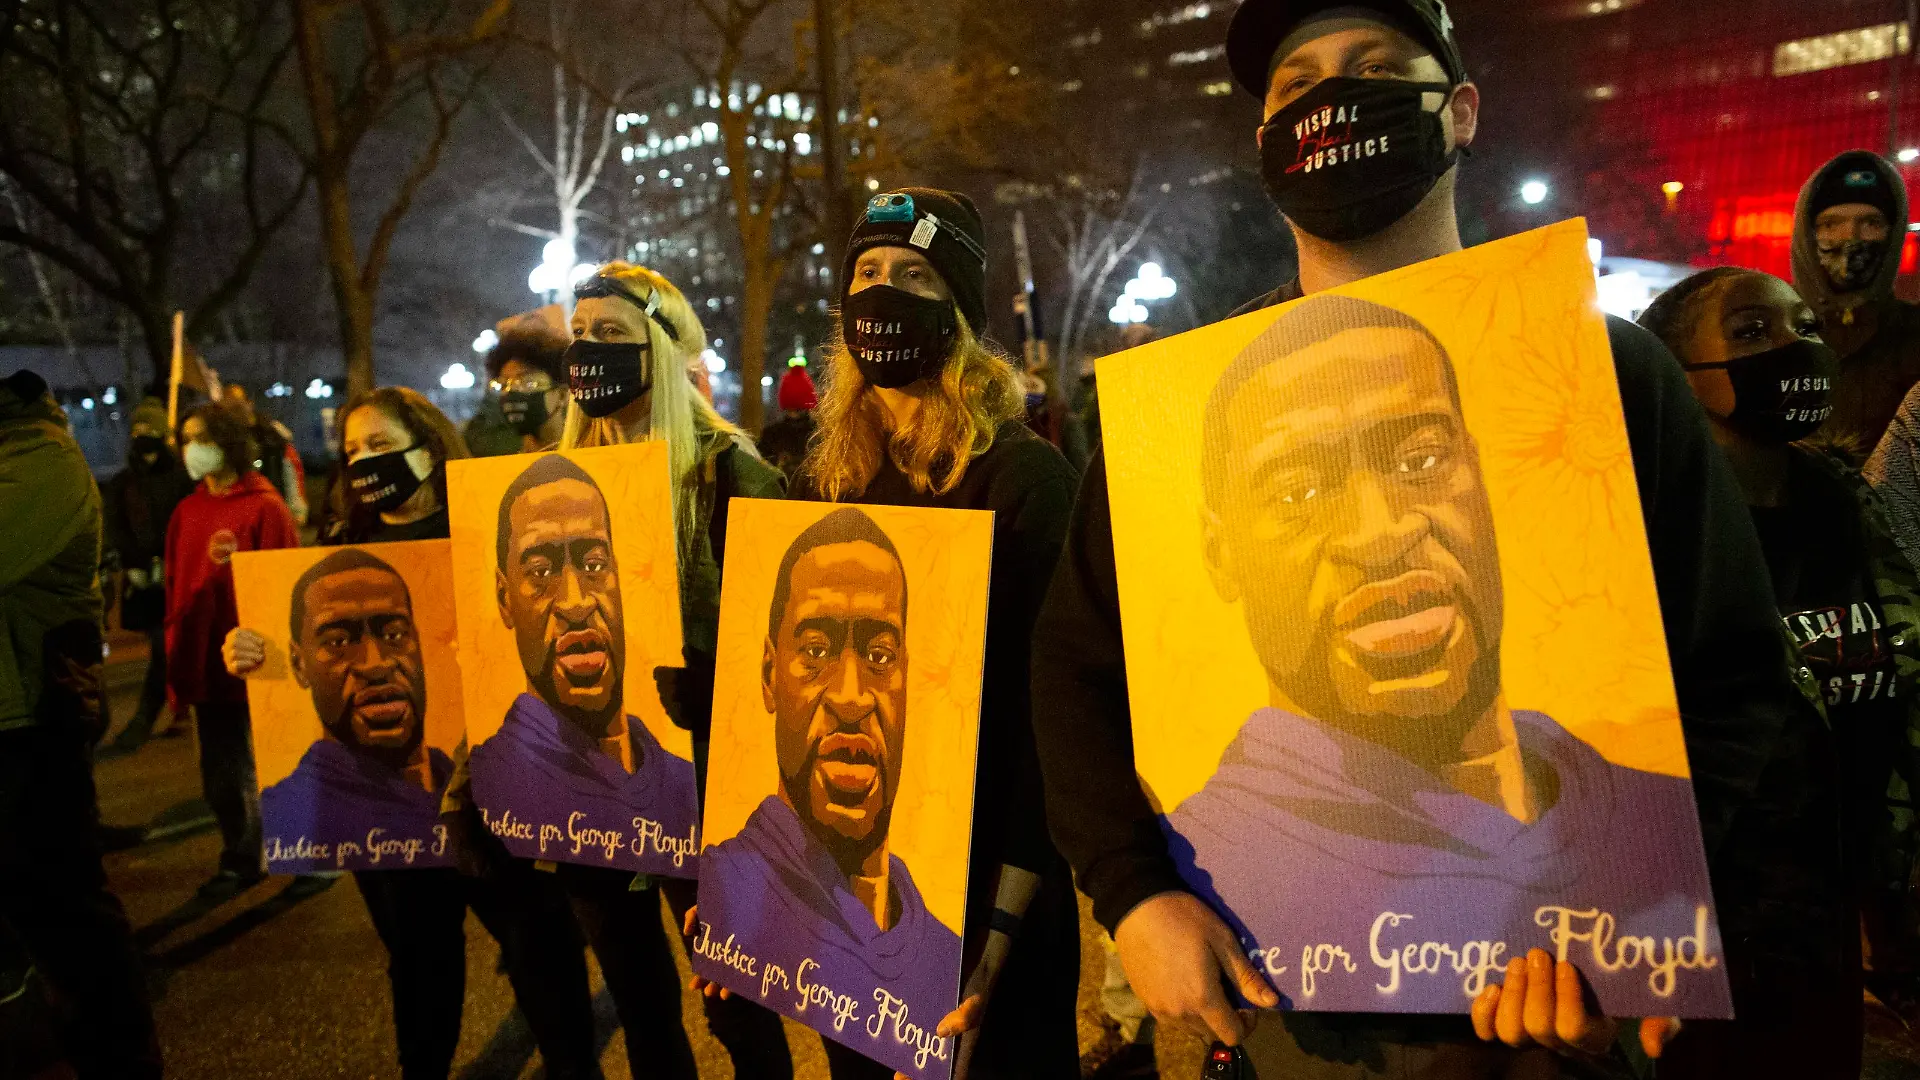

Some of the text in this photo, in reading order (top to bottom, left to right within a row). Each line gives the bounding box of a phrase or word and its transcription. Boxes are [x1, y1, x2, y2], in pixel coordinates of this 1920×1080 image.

[1295, 104, 1359, 141] VISUAL
[1304, 136, 1389, 173] JUSTICE
[856, 319, 903, 334] VISUAL
[860, 347, 921, 363] JUSTICE
[336, 841, 363, 868] for
[366, 826, 425, 865] George
[540, 823, 564, 853] for
[568, 810, 626, 861] George
[631, 816, 698, 868] Floyd
[1300, 944, 1357, 998] for
[1369, 910, 1508, 998] George
[1534, 904, 1718, 998] Floyd
[693, 921, 758, 977] Justice
[762, 962, 790, 998] for
[795, 957, 860, 1032] George
